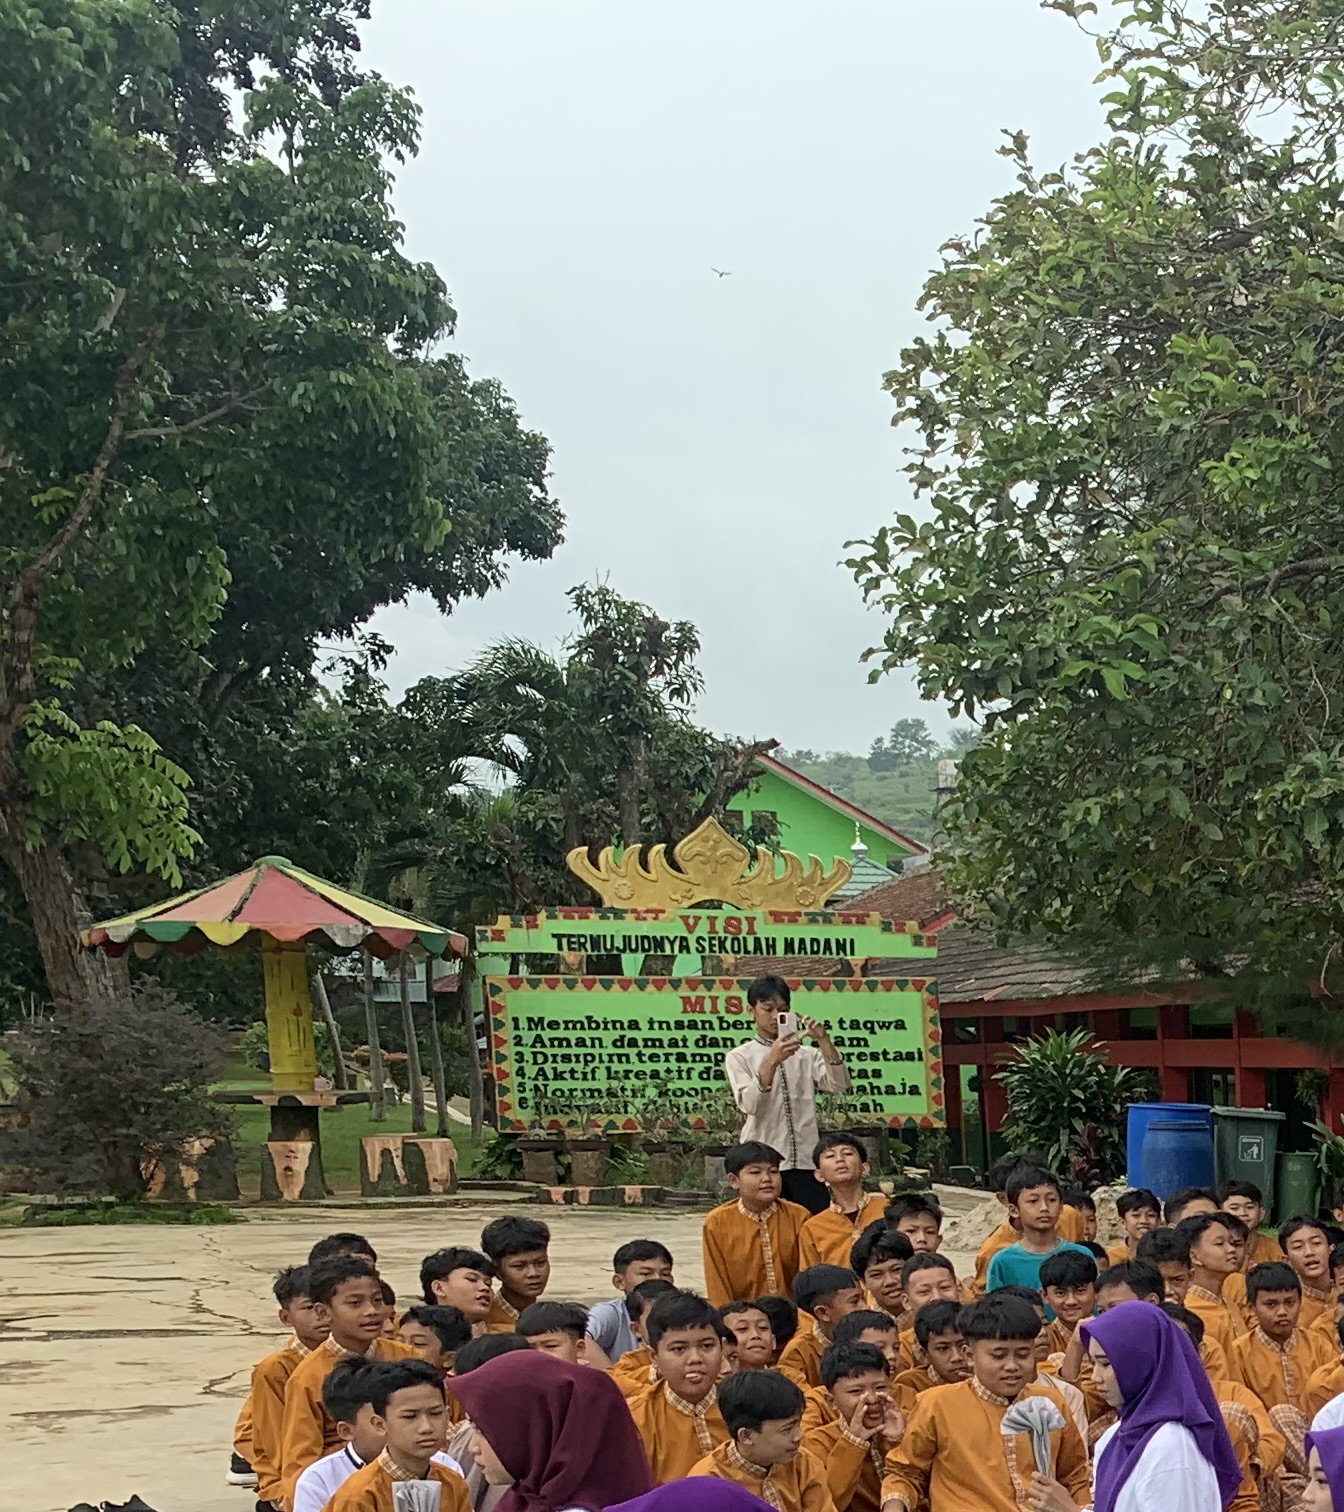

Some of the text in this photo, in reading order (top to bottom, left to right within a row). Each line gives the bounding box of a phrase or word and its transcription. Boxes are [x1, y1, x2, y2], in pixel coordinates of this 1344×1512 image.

[679, 915, 757, 936] VISI
[551, 933, 857, 956] TERWUJUDNYA SEKOLAH MADANI
[681, 995, 745, 1014] MIS
[647, 1017, 715, 1031] insan
[837, 1017, 907, 1034] taqwa
[611, 1035, 690, 1049] damai
[694, 1034, 736, 1048] dan
